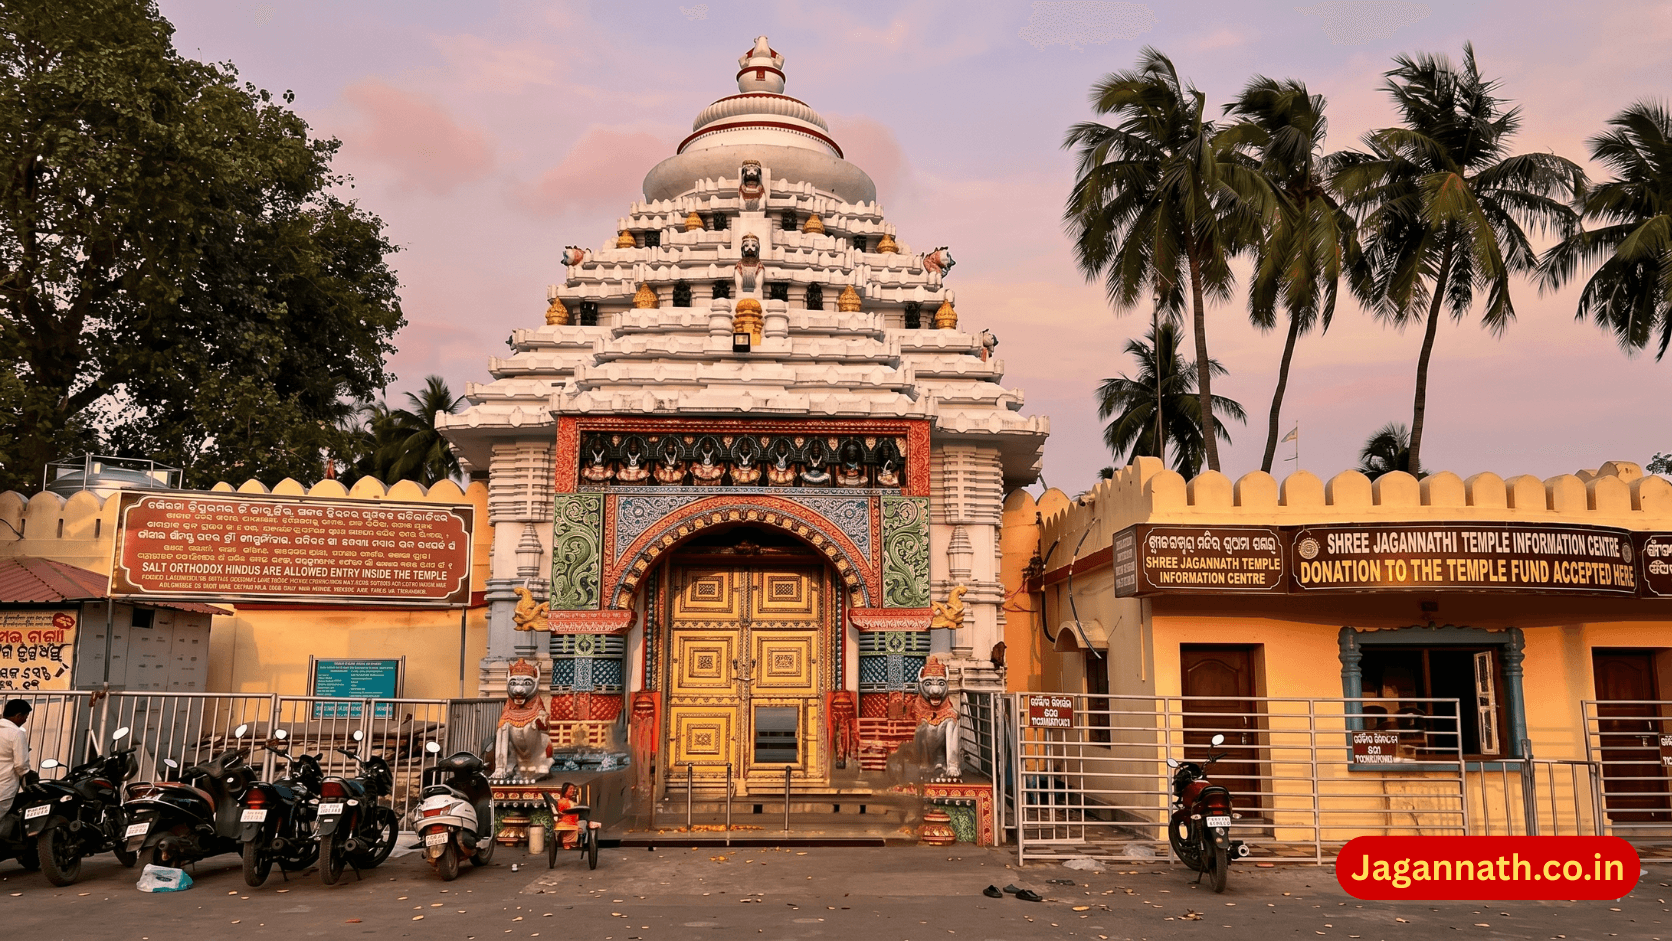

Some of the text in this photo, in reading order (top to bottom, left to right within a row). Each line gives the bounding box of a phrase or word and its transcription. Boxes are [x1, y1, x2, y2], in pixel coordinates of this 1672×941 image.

[1327, 532, 1370, 554] SHREE
[1461, 531, 1511, 554] TEMPLE
[1512, 532, 1585, 556] INFORMATION
[1587, 535, 1620, 558] CENTRE
[142, 562, 448, 581] SALT ORTHODOX HINDUS ARE ALLOWED ENTRY INSIDE THE TEMPLE
[1146, 556, 1281, 570] SHREE JAGANNATH TEMPLE
[1300, 558, 1635, 587] DONATION TO THE TEMPLE FUND ACCEPTED HERE
[1160, 571, 1266, 585] INFORMATION CENTRE
